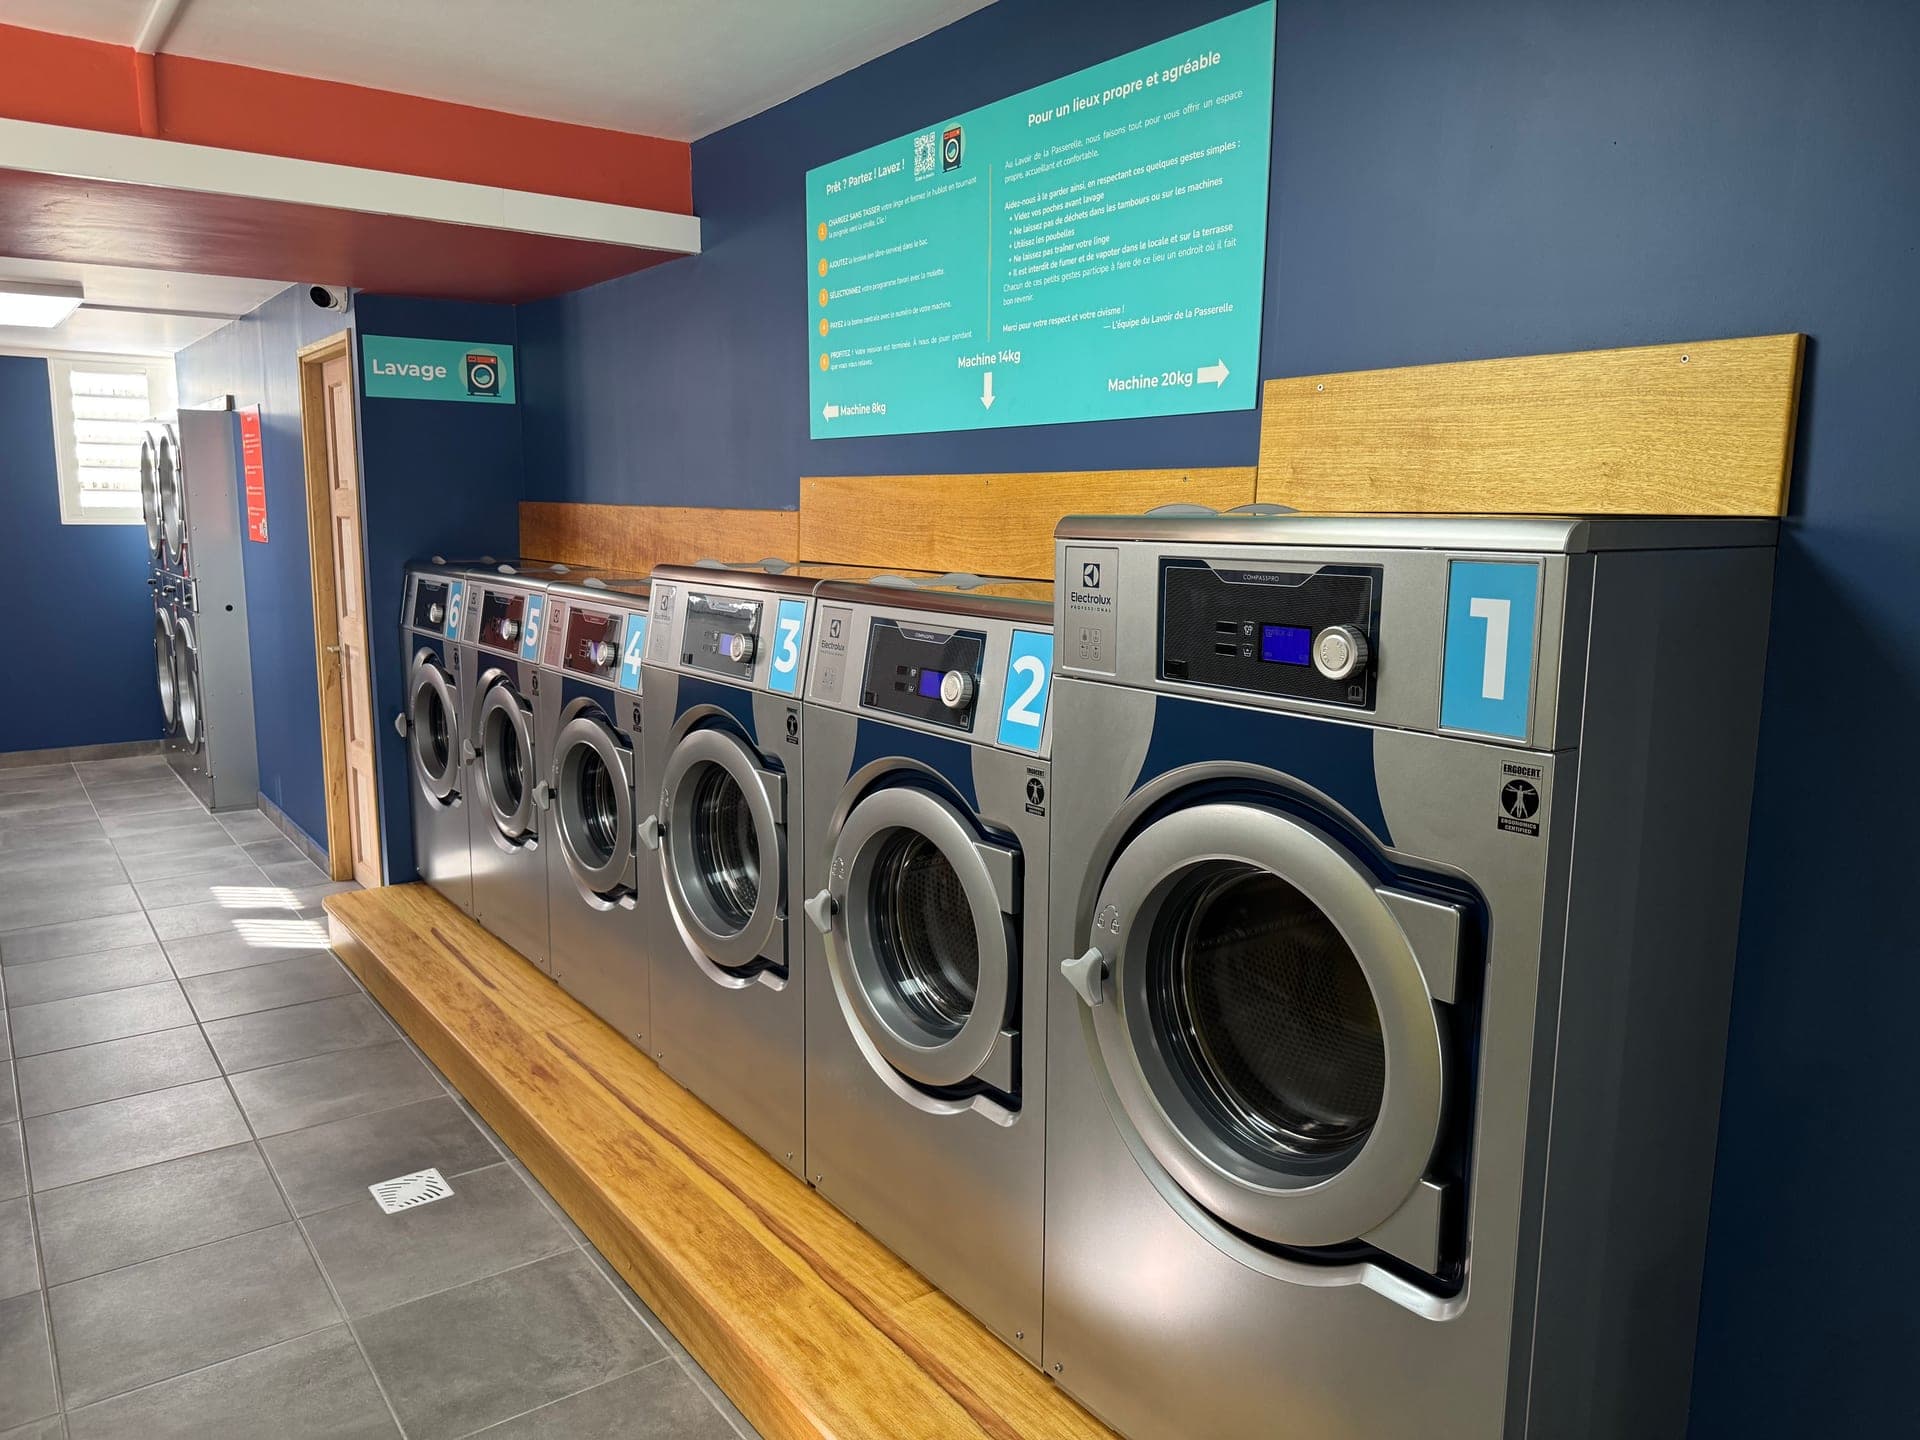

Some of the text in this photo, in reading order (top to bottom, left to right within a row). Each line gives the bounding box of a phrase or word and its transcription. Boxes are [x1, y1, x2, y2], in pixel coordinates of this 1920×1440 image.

[1028, 52, 1220, 126] Pour un lieux propre et agréable
[1014, 155, 1031, 166] Lavoir
[1033, 152, 1041, 160] de
[1043, 149, 1049, 157] la
[1085, 134, 1100, 144] nous
[1103, 126, 1125, 138] faisons
[1128, 120, 1142, 131] tout
[1144, 115, 1160, 127] pour
[1163, 109, 1180, 120] vous
[1182, 103, 1200, 114] offrir
[1203, 99, 1213, 108] un
[1215, 90, 1242, 104] espace
[826, 181, 841, 194] Prêt
[848, 172, 872, 186] Partez
[878, 162, 900, 177] Lavez
[1004, 196, 1036, 209] Aidez-nous
[1036, 192, 1041, 201] à
[1041, 192, 1048, 200] le
[1048, 187, 1068, 200] garder
[1096, 169, 1132, 185] respectant
[1132, 166, 1144, 175] ces
[1145, 157, 1178, 172] quelques
[1179, 150, 1204, 164] gestes
[1206, 141, 1236, 155] simples
[1025, 162, 1055, 176] accueillant
[1055, 159, 1063, 167] et
[1013, 178, 1222, 235] Ne laissez pas de déchets dans les tambours ou sur les machines
[1014, 212, 1030, 220] Videz
[1042, 203, 1063, 215] poches
[1064, 197, 1082, 208] avant
[1083, 192, 1104, 203] lavage
[1013, 229, 1074, 249] Utilisez les poubelles
[1018, 267, 1027, 275] est
[1028, 262, 1049, 273] interdit
[1058, 257, 1077, 266] fumer
[1078, 255, 1085, 263] et
[1086, 252, 1094, 261] de
[1095, 248, 1120, 259] vapoter
[1121, 244, 1138, 253] dans
[1139, 241, 1146, 250] le
[1147, 236, 1168, 248] locale
[1170, 234, 1178, 243] et
[1179, 232, 1191, 241] sur
[1192, 229, 1200, 238] la
[1202, 224, 1233, 236] terrasse
[1022, 251, 1041, 261] laissez
[1042, 248, 1053, 257] pas
[1075, 239, 1092, 248] votre
[1093, 235, 1110, 245] linge
[1003, 237, 1236, 292] Chacun de ces petits gestes participe à faire de ce lieu un endroit où il fait
[1002, 324, 1017, 332] Merci
[1018, 322, 1031, 331] pour
[1032, 319, 1047, 327] votre
[1048, 315, 1070, 325] respect
[1071, 313, 1078, 321] et
[1079, 311, 1096, 319] votre
[1096, 307, 1121, 317] civisme
[1140, 316, 1150, 325] du
[1151, 312, 1173, 323] Lavoir
[1174, 311, 1184, 319] de
[1185, 309, 1193, 318] la
[1194, 303, 1233, 316] Passerelle
[373, 359, 447, 381] Lavage
[958, 349, 1020, 367] Machine 14kg
[1108, 371, 1192, 391] Machine 20kg
[840, 402, 886, 415] Machine 8kg
[1242, 574, 1280, 582] COMPASSPRO
[449, 594, 461, 628] 6
[1071, 591, 1112, 605] Electrolux
[525, 608, 540, 647] 5
[625, 631, 642, 675] 4
[774, 618, 801, 673] 3
[821, 639, 845, 652] Electrolux
[1469, 597, 1511, 700] 1
[1006, 655, 1046, 728] 2
[1503, 764, 1541, 777] ERGOCERT
